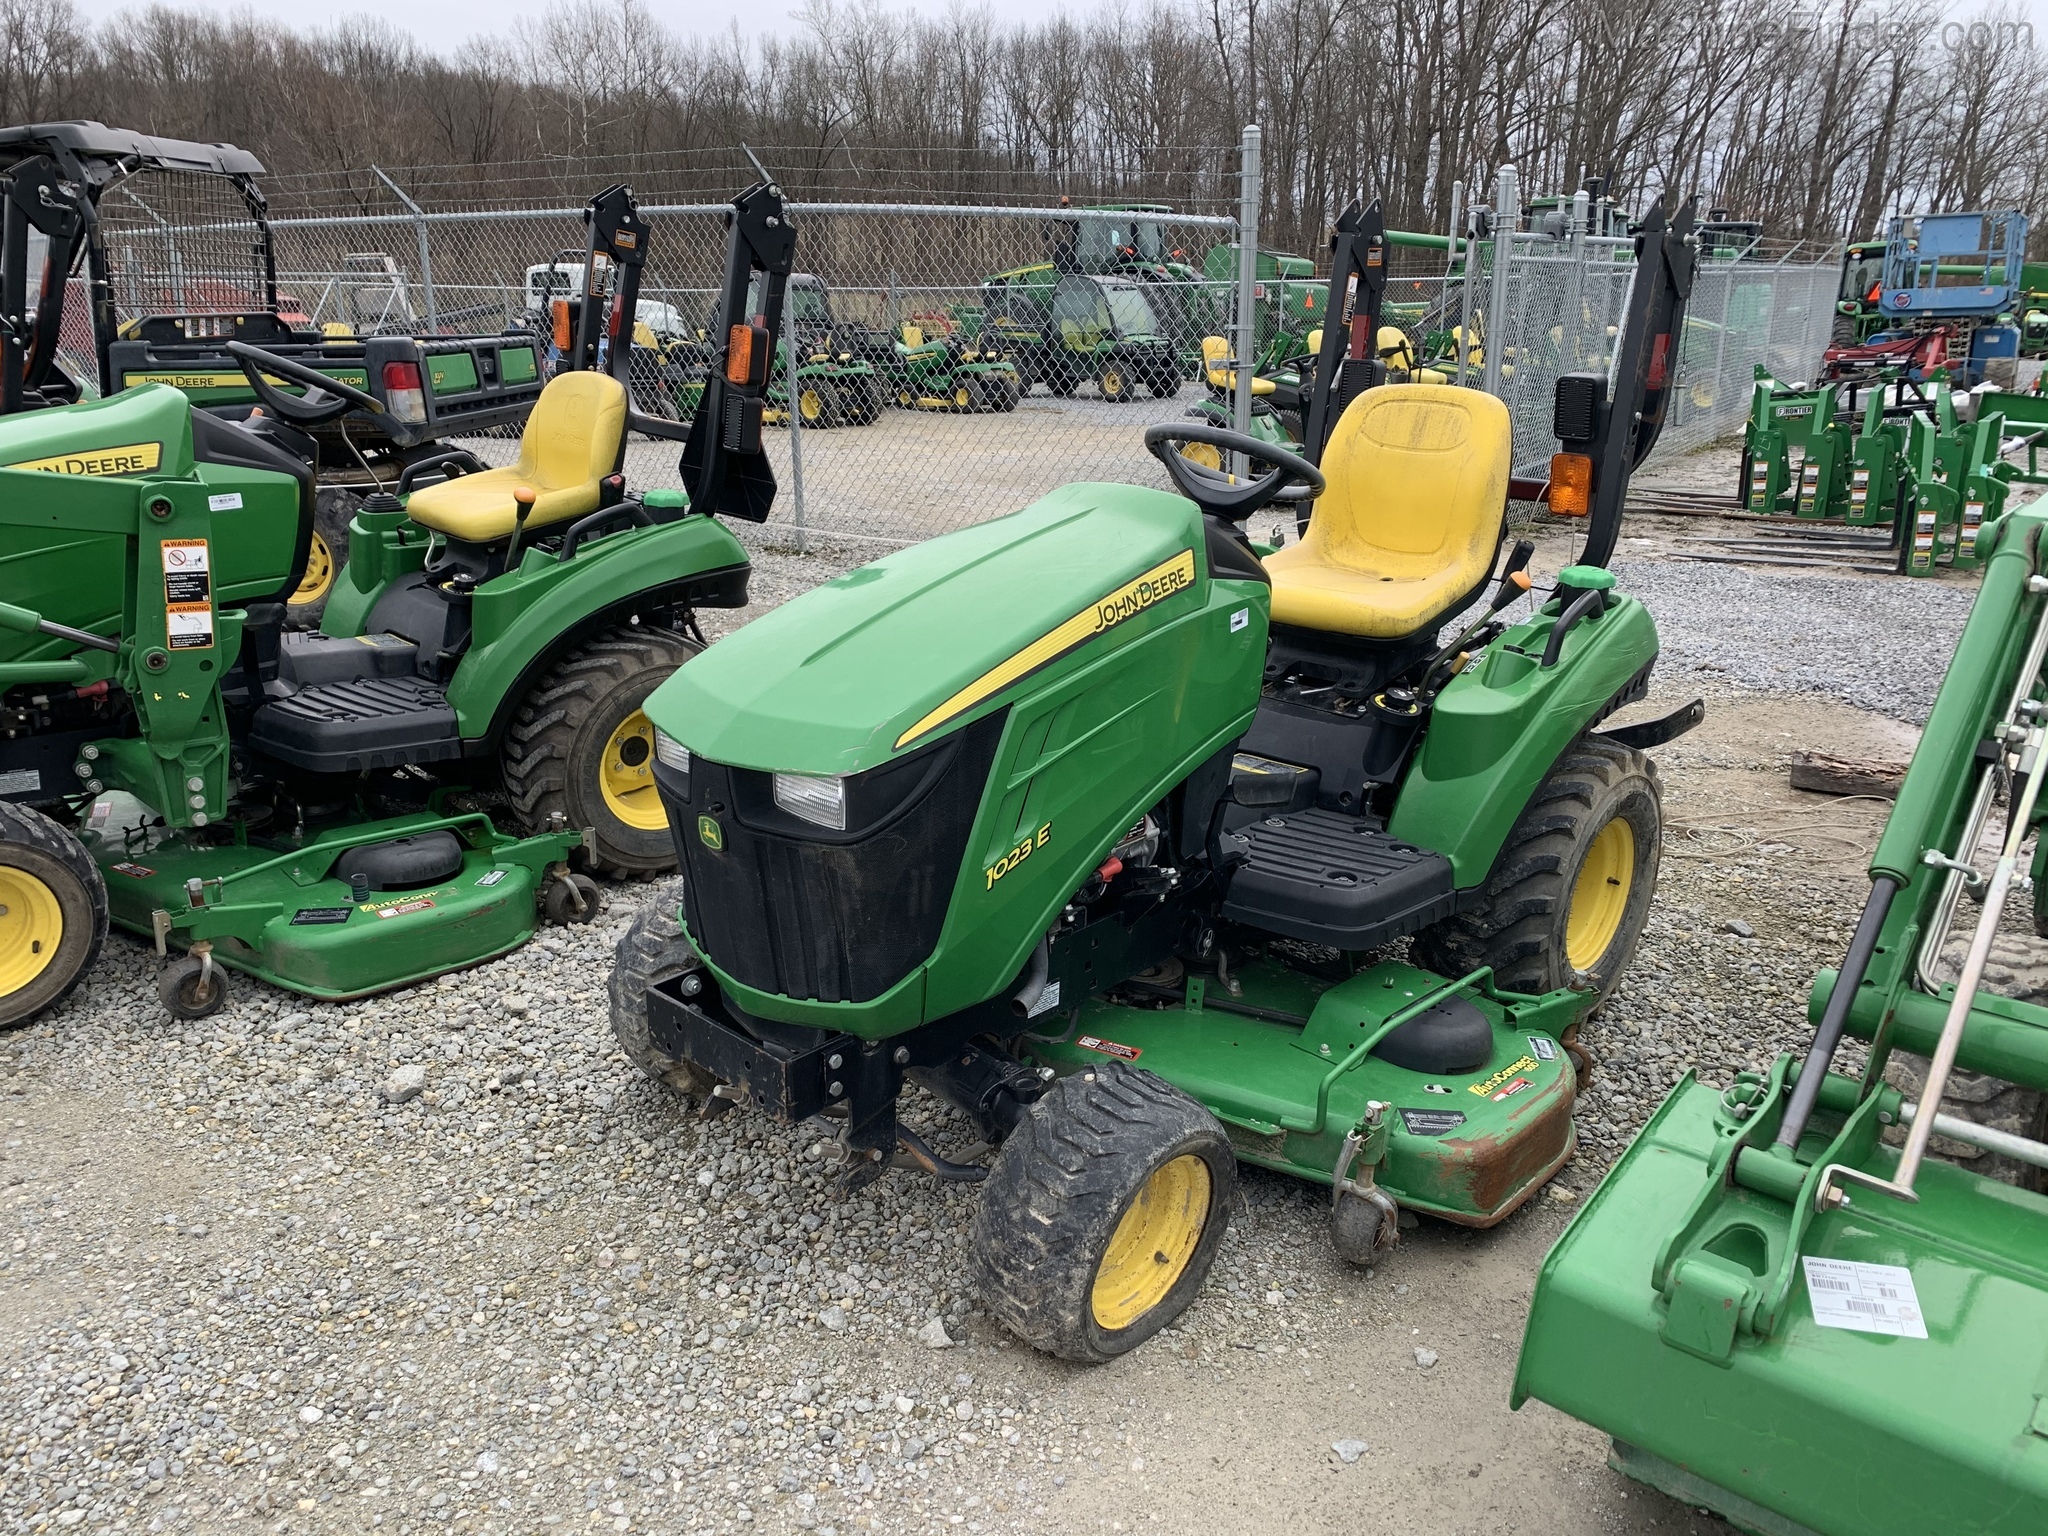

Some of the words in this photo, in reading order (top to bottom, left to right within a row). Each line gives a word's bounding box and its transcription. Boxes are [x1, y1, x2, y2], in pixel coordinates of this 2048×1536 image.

[176, 376, 215, 387] DEERE
[1776, 406, 1813, 417] FRONTIER
[1883, 417, 1911, 426] FRONTI
[65, 455, 145, 475] DEERE
[170, 540, 206, 548] WARNING
[1095, 591, 1139, 630] JOHN
[1139, 567, 1188, 605] DEERE
[175, 604, 210, 612] WARNING
[986, 838, 1034, 892] 1023
[1036, 820, 1053, 850] E
[359, 890, 439, 913] AutoConn
[1467, 1054, 1535, 1098] AutoConnect
[1829, 1263, 1853, 1271] DEERE
